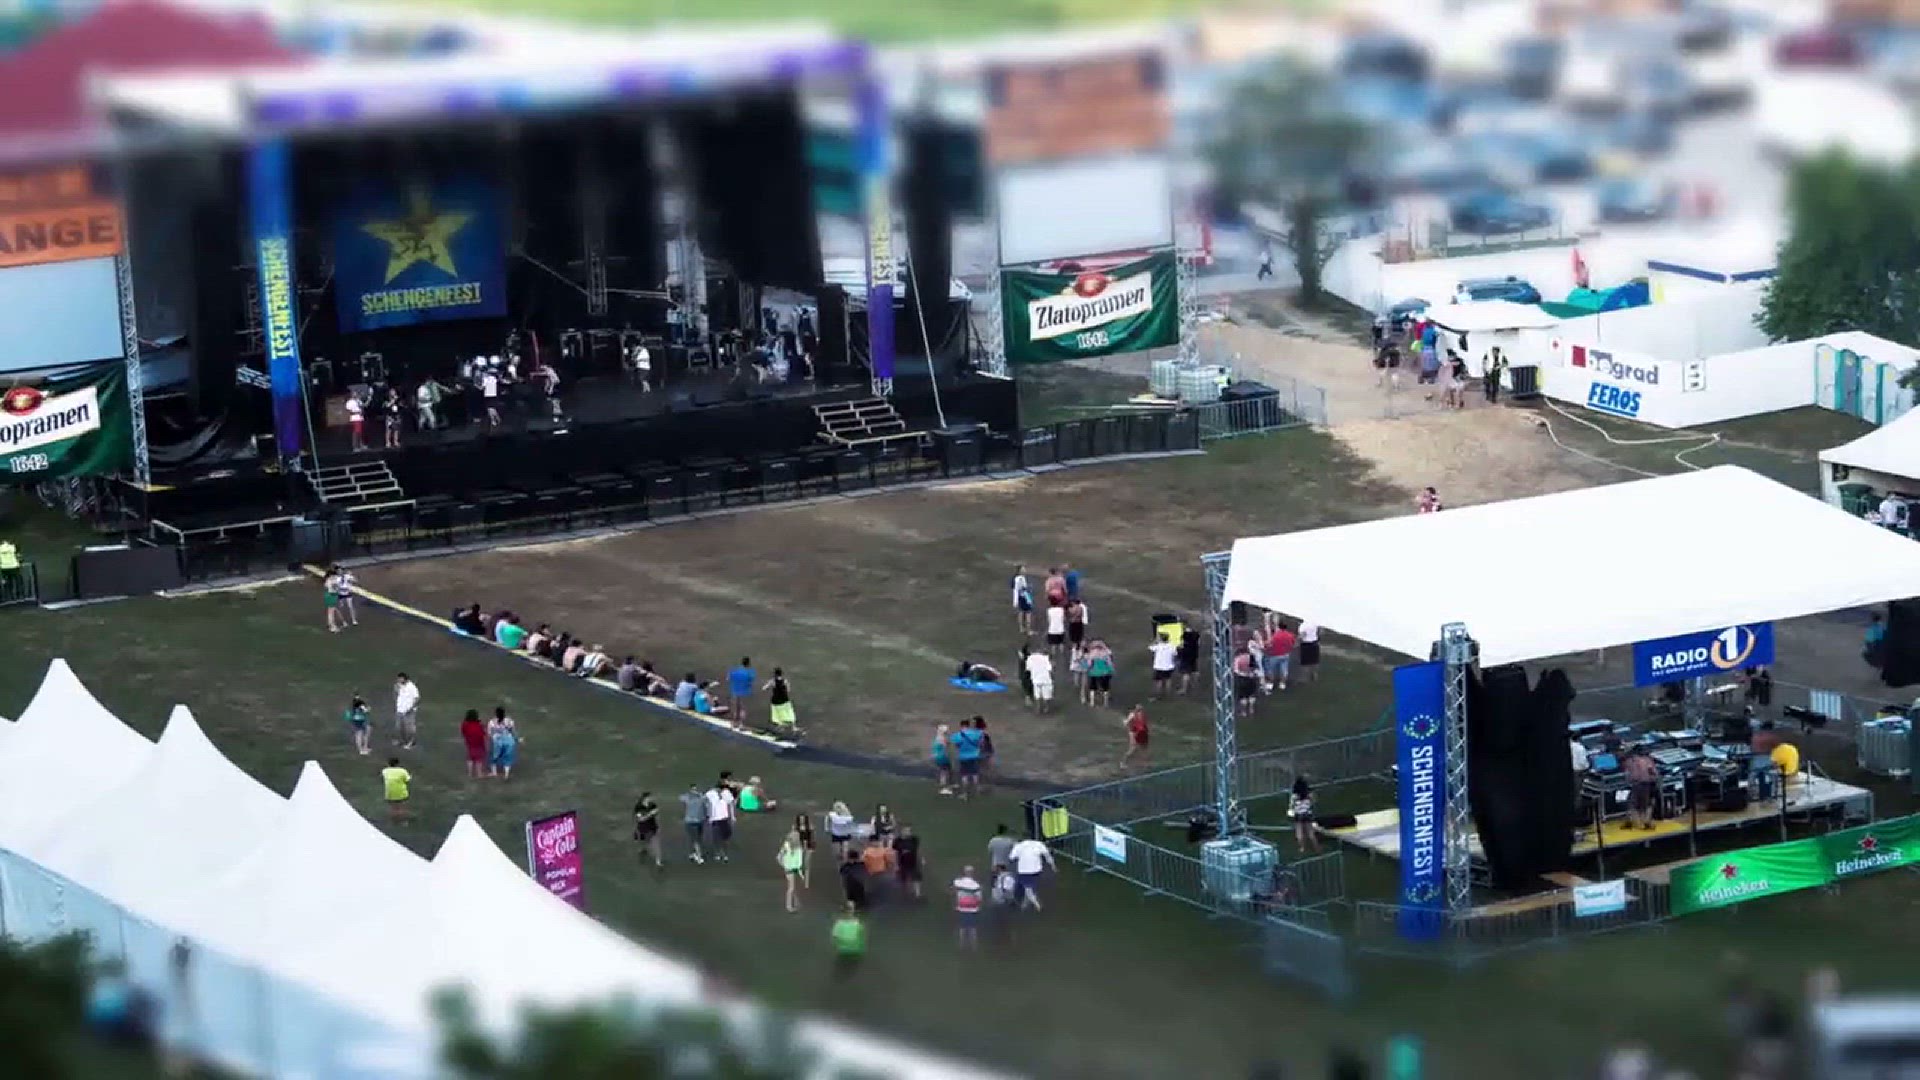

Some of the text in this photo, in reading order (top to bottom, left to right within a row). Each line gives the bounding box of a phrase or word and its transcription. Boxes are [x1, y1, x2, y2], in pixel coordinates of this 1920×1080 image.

[361, 282, 482, 316] SCHENGENFEST
[1035, 287, 1146, 330] Zlatopramen
[1076, 331, 1110, 349] 1642
[1588, 381, 1642, 413] FEROS
[0, 403, 90, 446] opramen
[10, 453, 49, 474] 1642
[1651, 647, 1708, 670] RADIO
[1717, 626, 1739, 661] 1
[1411, 745, 1434, 877] SCHENGENFEST
[537, 816, 575, 850] Captain
[555, 835, 576, 858] Cola
[1836, 848, 1902, 875] Heineken
[1699, 879, 1769, 903] Heineken
